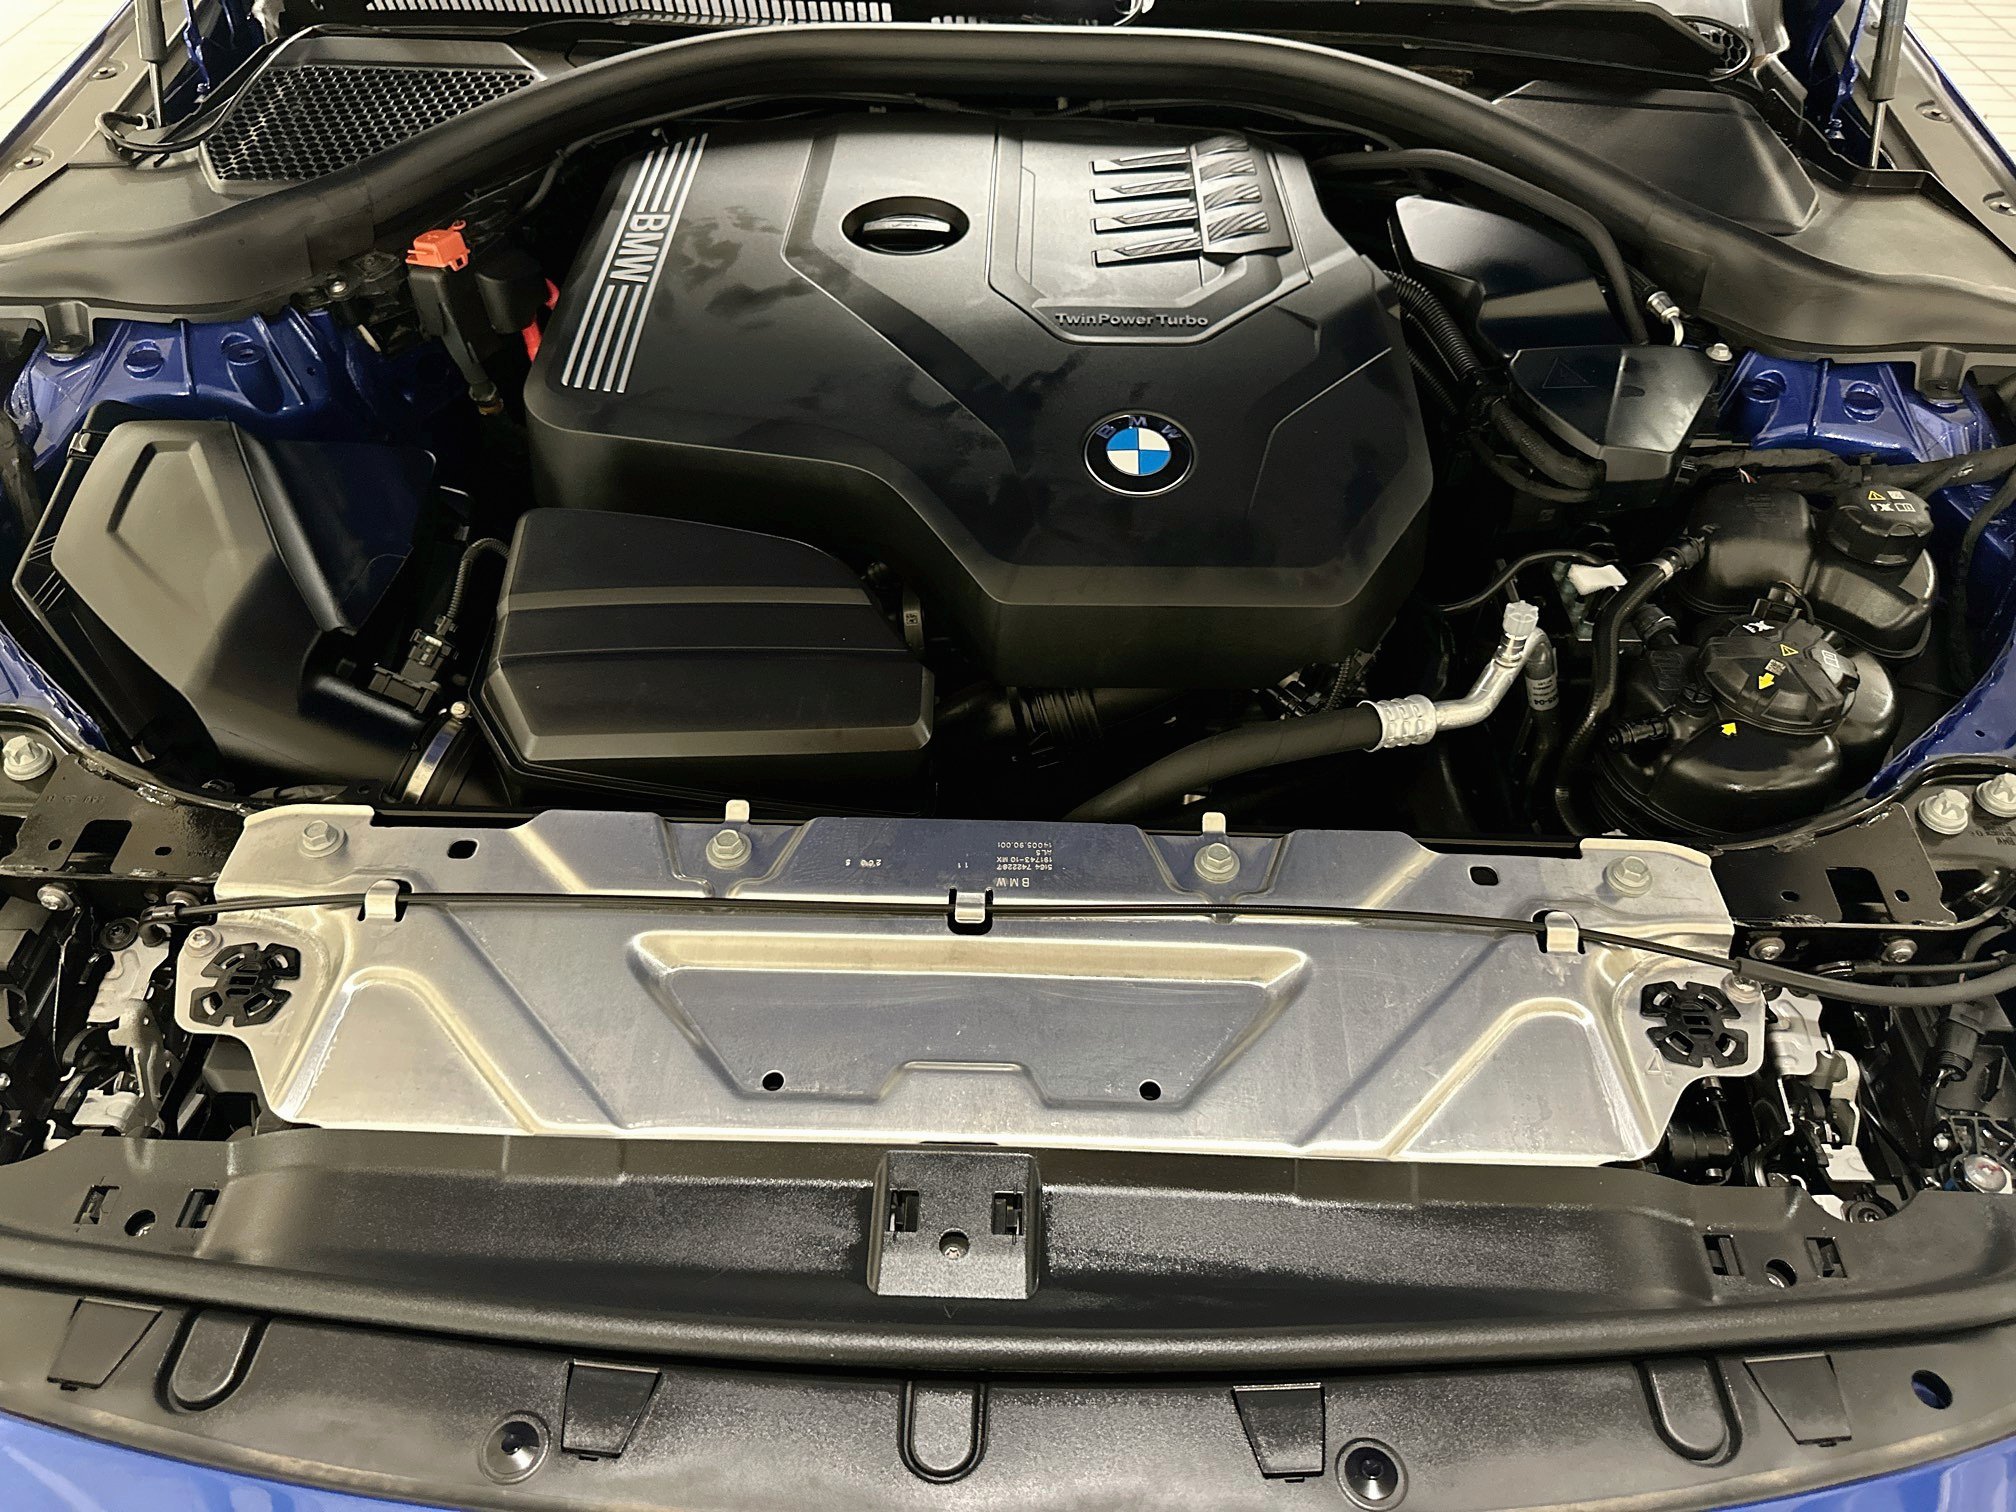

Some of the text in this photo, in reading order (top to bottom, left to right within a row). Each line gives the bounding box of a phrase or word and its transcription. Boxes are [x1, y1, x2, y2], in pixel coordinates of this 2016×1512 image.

[609, 213, 672, 284] BMW
[1055, 312, 1209, 327] TwinPower Turbo
[1096, 415, 1182, 439] BMW
[995, 877, 1030, 888] BMW
